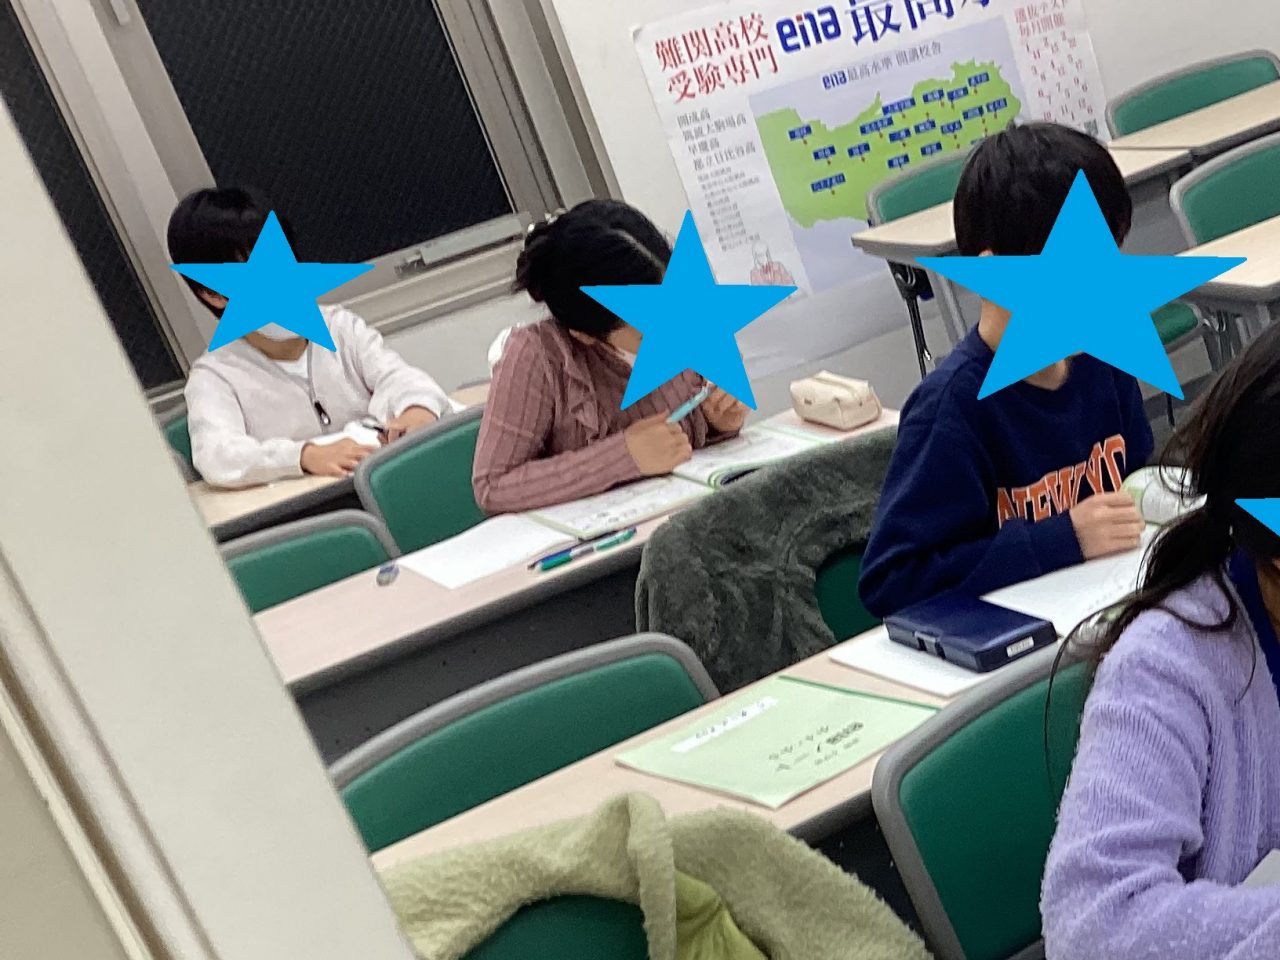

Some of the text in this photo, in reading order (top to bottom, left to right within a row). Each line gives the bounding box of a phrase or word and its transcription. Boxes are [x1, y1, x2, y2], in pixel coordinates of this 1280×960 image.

[655, 12, 768, 71] 難関高校
[776, 6, 842, 53] ena
[668, 45, 778, 104] 受験専門
